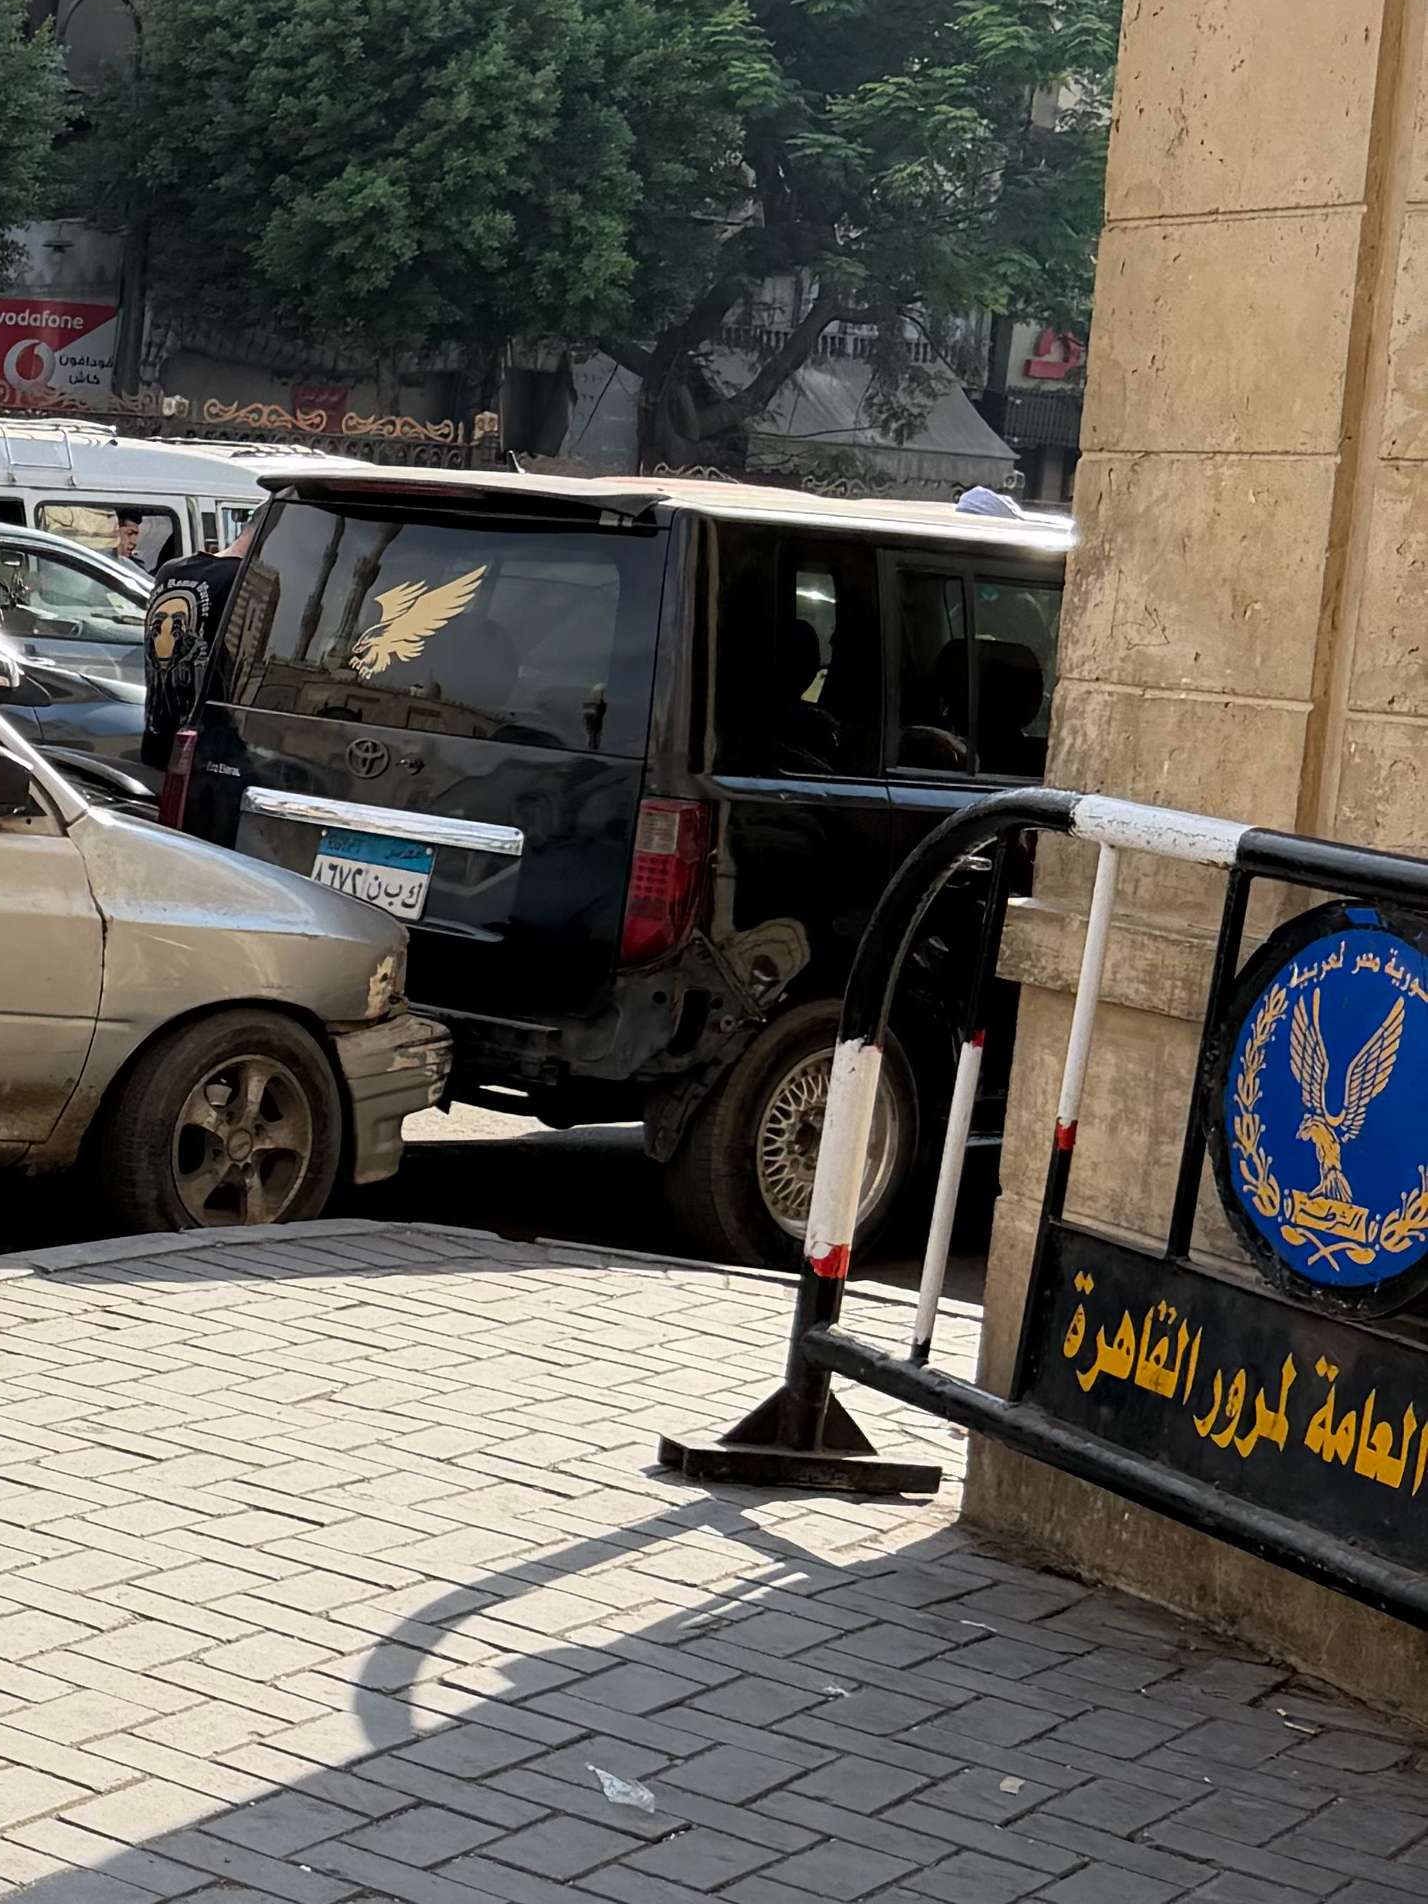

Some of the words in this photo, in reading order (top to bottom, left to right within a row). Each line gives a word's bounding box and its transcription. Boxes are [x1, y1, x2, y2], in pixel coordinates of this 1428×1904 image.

[69, 371, 101, 385] كاش
[1062, 1269, 1204, 1407] القاهرة
[1192, 1351, 1297, 1459] لمرور
[1304, 1354, 1428, 1497] العامة
